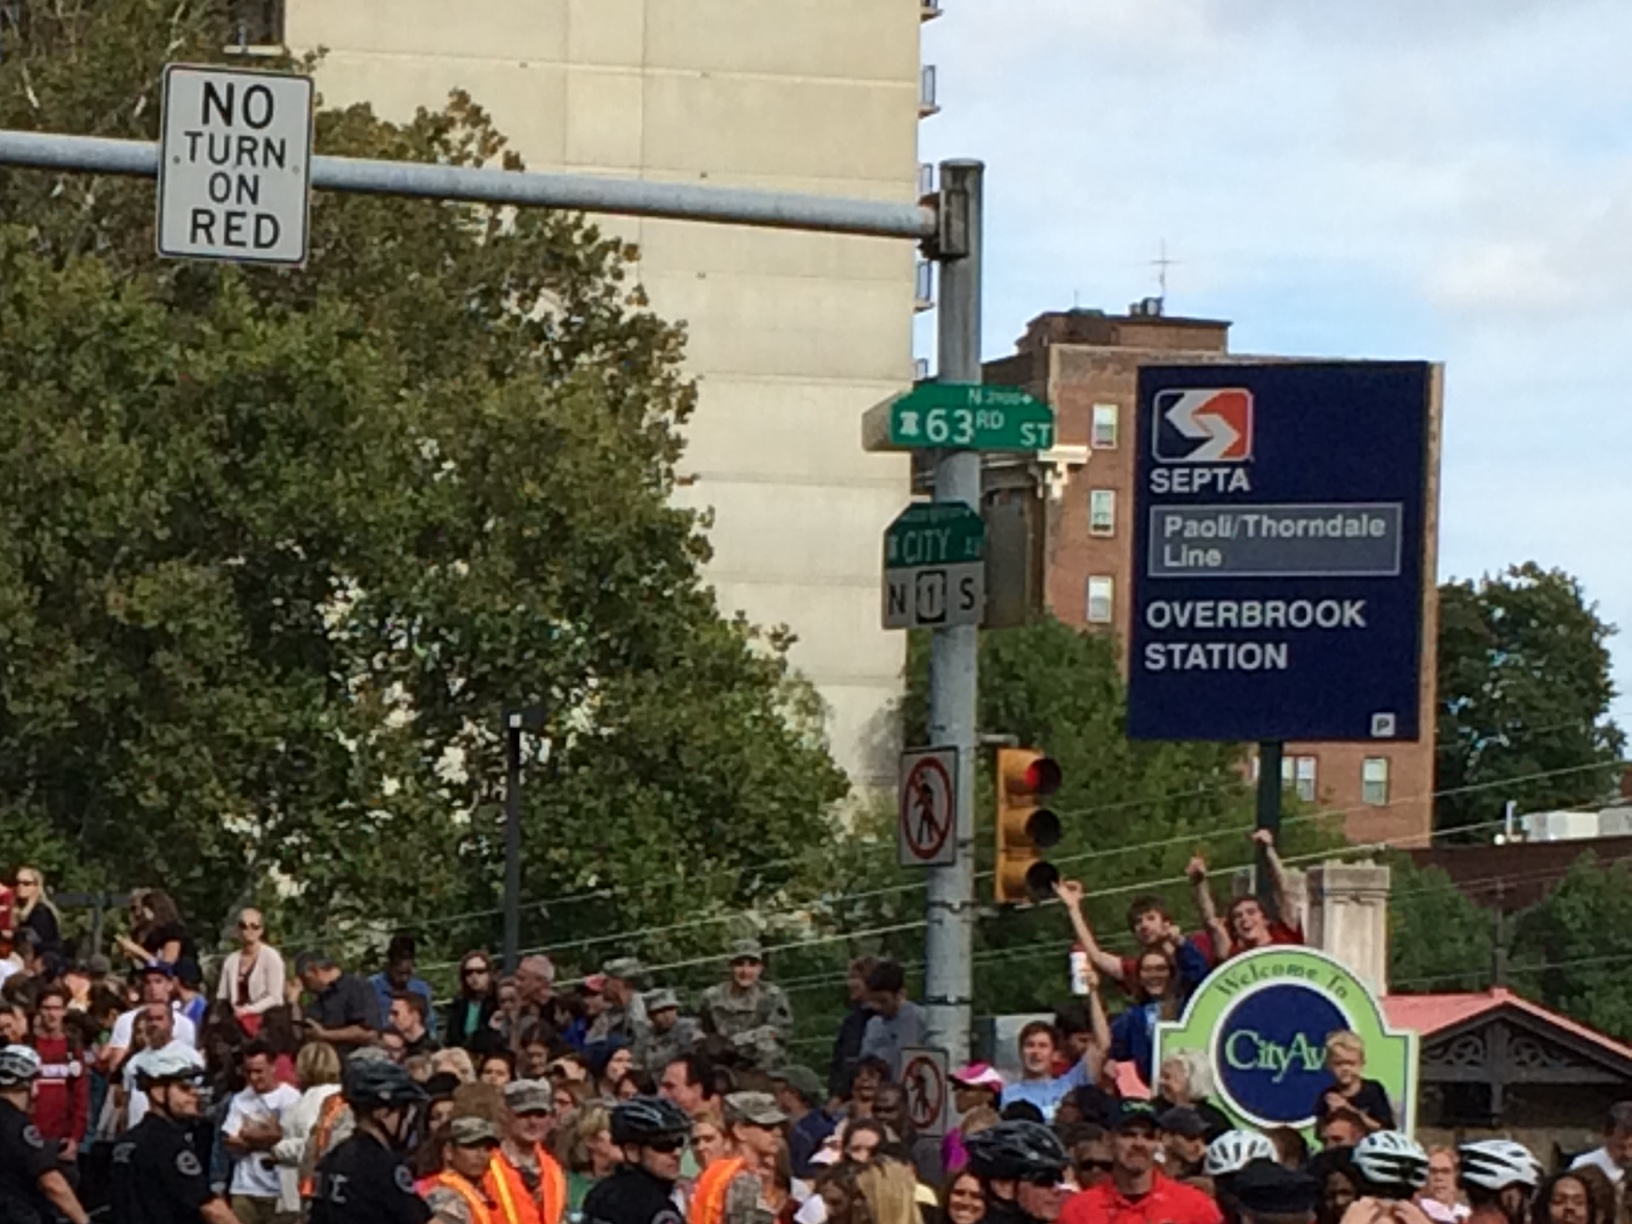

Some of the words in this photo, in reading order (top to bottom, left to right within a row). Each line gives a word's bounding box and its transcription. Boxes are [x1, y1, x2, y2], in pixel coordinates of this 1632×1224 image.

[202, 81, 274, 129] NO
[184, 130, 285, 169] TURN
[208, 172, 259, 205] ON
[189, 208, 280, 248] RED
[1020, 422, 1052, 446] ST
[1150, 467, 1250, 493] SEPTA
[1164, 514, 1386, 539] Paoli/Thorndale
[902, 527, 950, 563] CITY
[1164, 544, 1222, 567] Line
[889, 582, 906, 615] N
[959, 577, 975, 611] S
[1146, 600, 1366, 628] OVERBROOK
[1144, 643, 1288, 670] STATION
[1215, 962, 1318, 996] Welcome
[1224, 1030, 1328, 1083] CityAv
